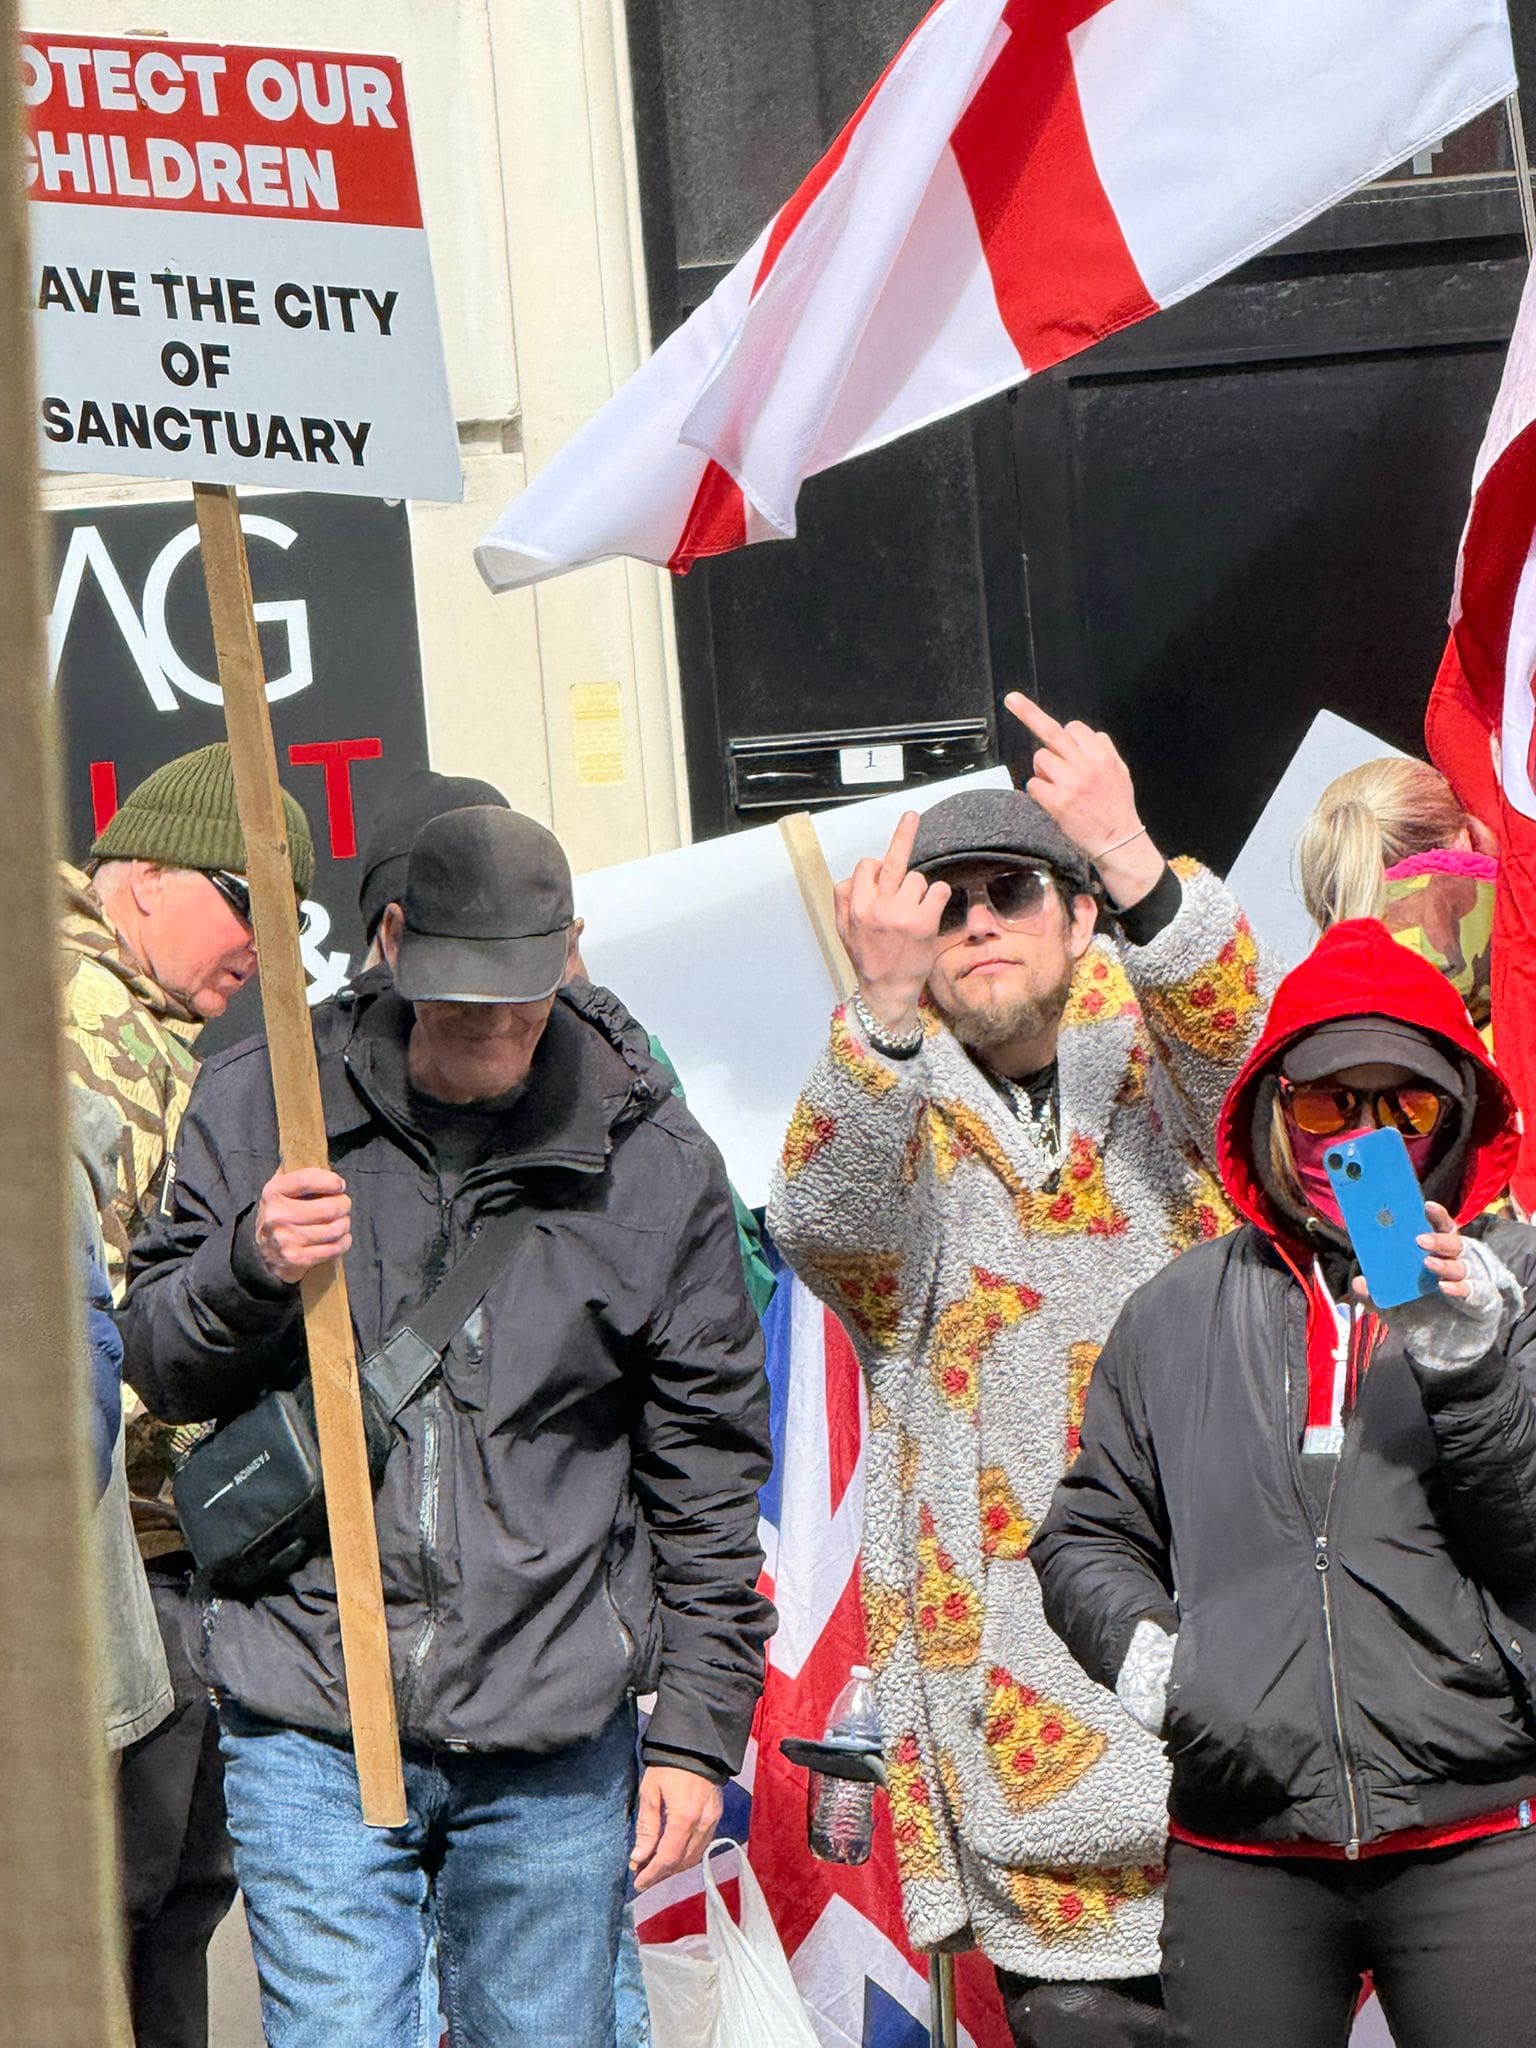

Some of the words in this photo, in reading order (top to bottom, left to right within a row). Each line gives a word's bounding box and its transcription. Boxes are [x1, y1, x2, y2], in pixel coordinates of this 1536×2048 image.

[246, 58, 399, 129] OUR
[39, 265, 141, 317] AVE
[151, 271, 260, 326] THE
[273, 282, 399, 336] CITY
[161, 340, 230, 389] OF
[43, 397, 371, 467] SANCTUARY
[864, 750, 877, 768] 1
